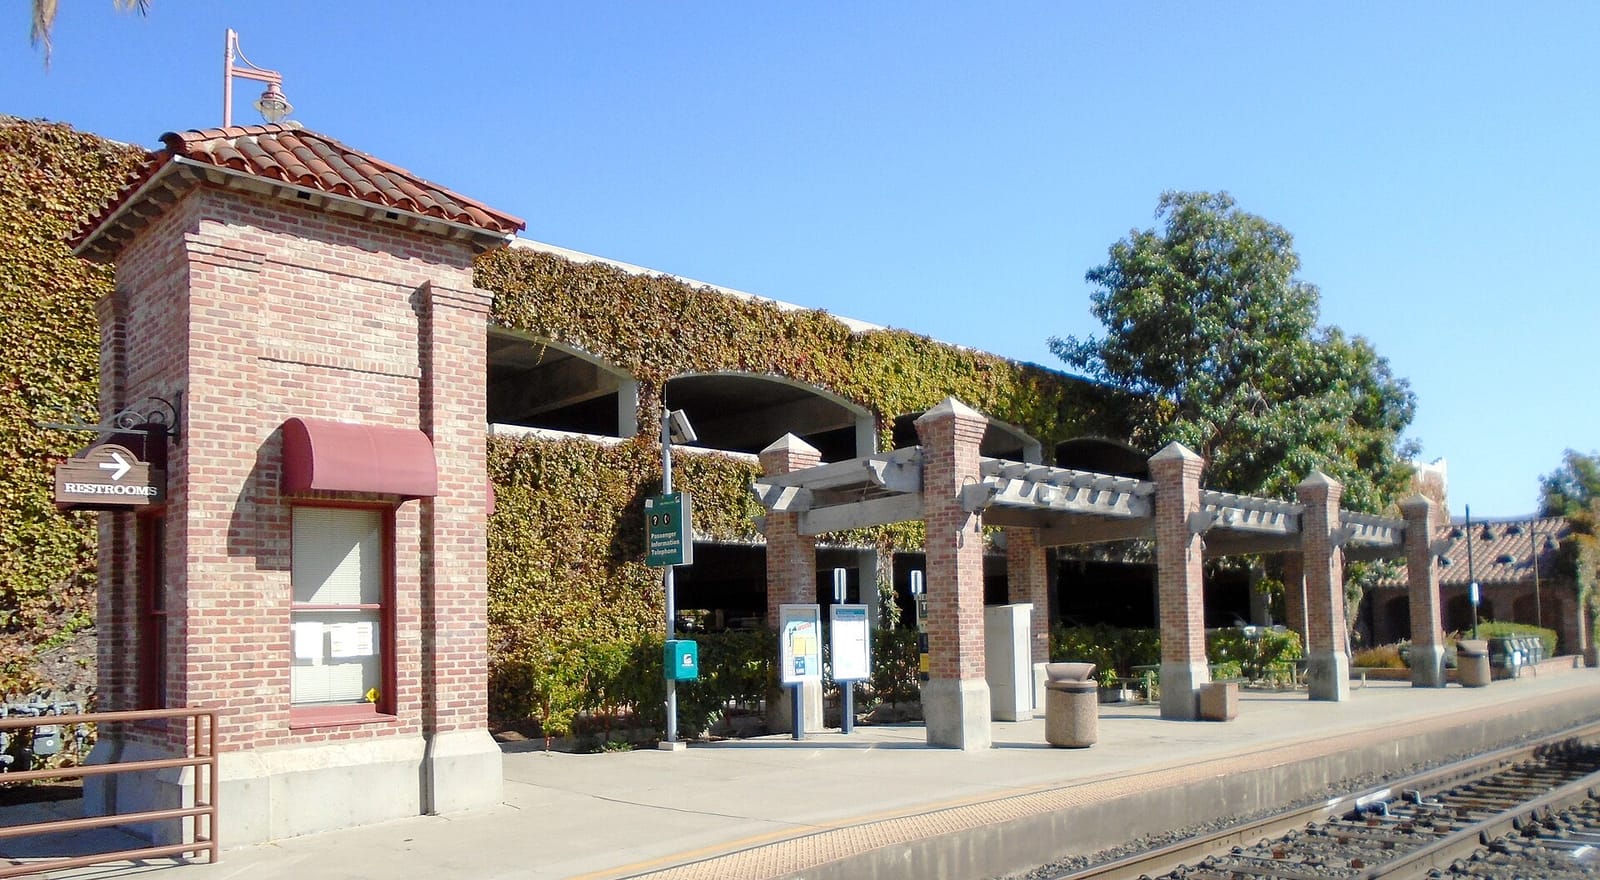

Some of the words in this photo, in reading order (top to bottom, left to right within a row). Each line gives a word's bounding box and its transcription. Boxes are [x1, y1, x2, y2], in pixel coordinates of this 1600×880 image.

[64, 482, 157, 496] RESTROOMS
[651, 531, 677, 539] Passenger
[651, 540, 680, 548] Information
[651, 548, 677, 556] Telephone
